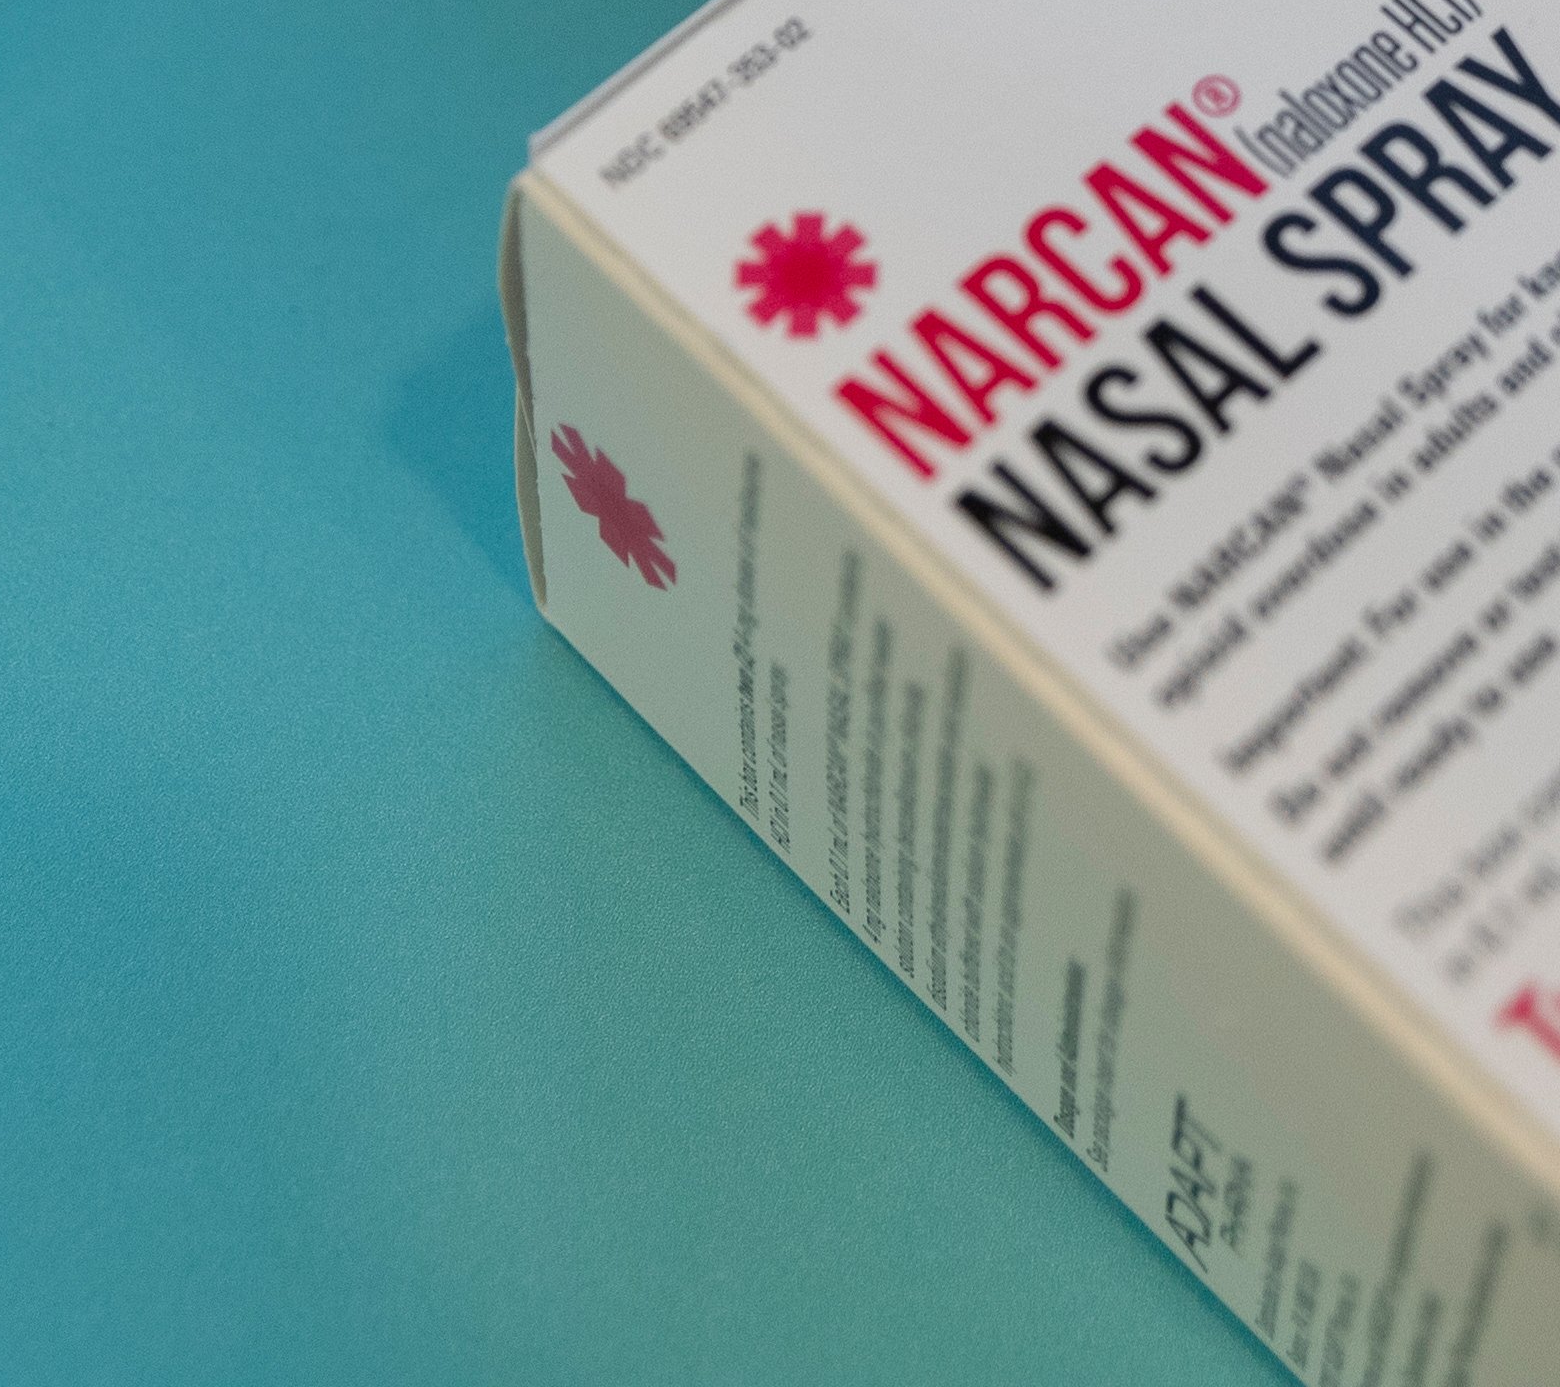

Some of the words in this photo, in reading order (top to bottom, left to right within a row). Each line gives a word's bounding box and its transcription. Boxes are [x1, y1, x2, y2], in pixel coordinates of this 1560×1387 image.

[1234, 30, 1420, 178] (naloxone
[953, 284, 1322, 593] NASAL
[1313, 400, 1405, 483] Nasal
[1397, 333, 1491, 409] Spray
[1477, 294, 1527, 338] for
[1412, 393, 1500, 475] adults
[1497, 339, 1554, 397] and
[738, 758, 758, 793] box
